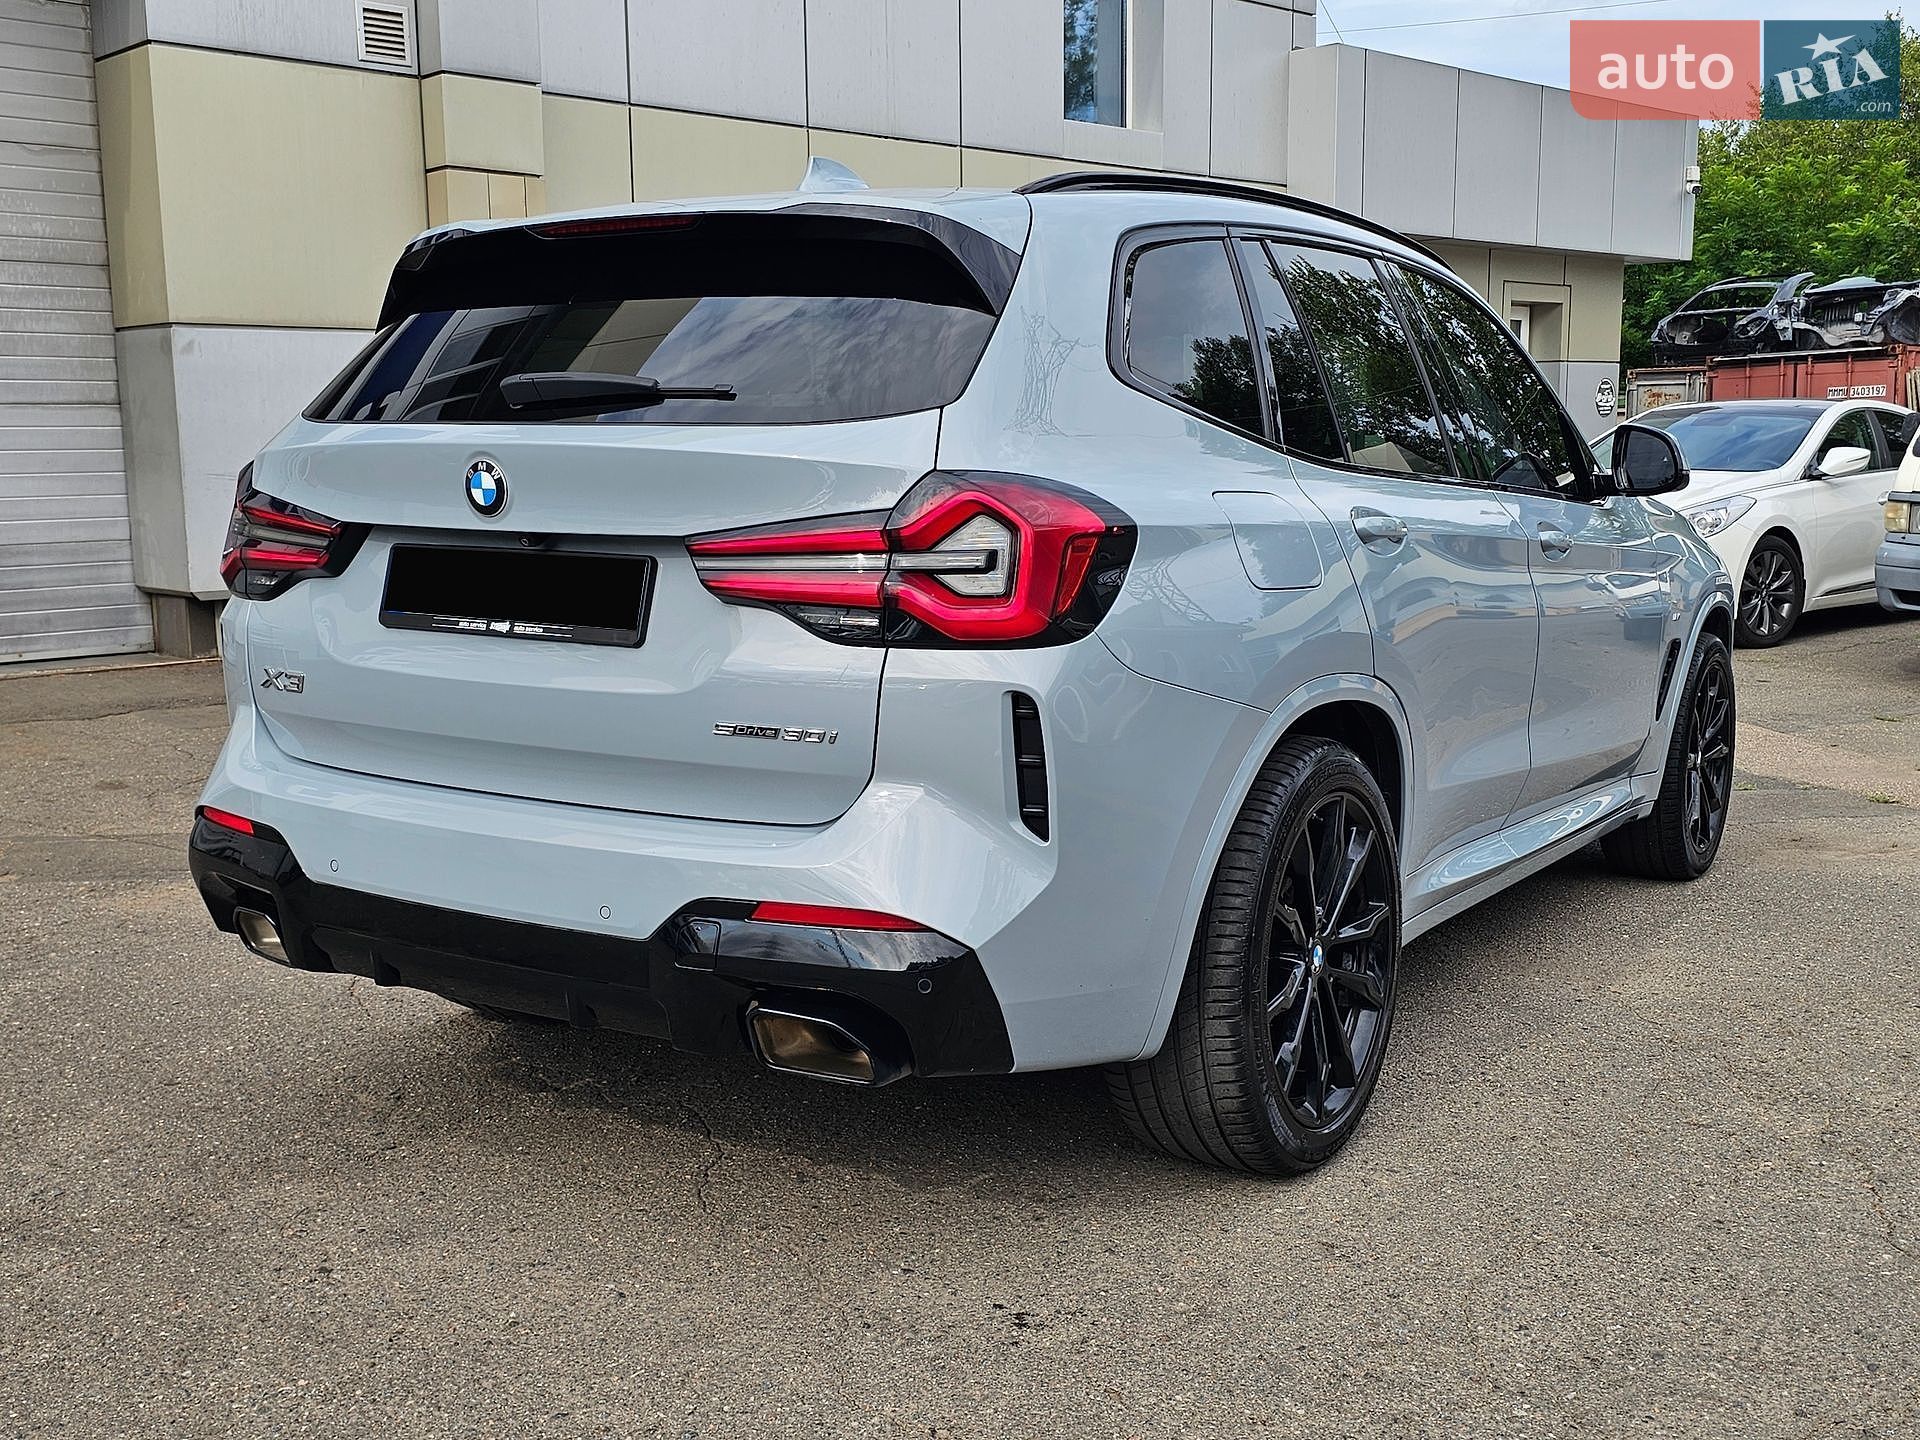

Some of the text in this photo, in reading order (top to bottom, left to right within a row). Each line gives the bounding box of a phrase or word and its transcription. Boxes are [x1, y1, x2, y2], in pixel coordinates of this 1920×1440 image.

[1851, 386, 1885, 397] 3403197
[468, 462, 501, 480] BMW
[260, 668, 305, 694] X3
